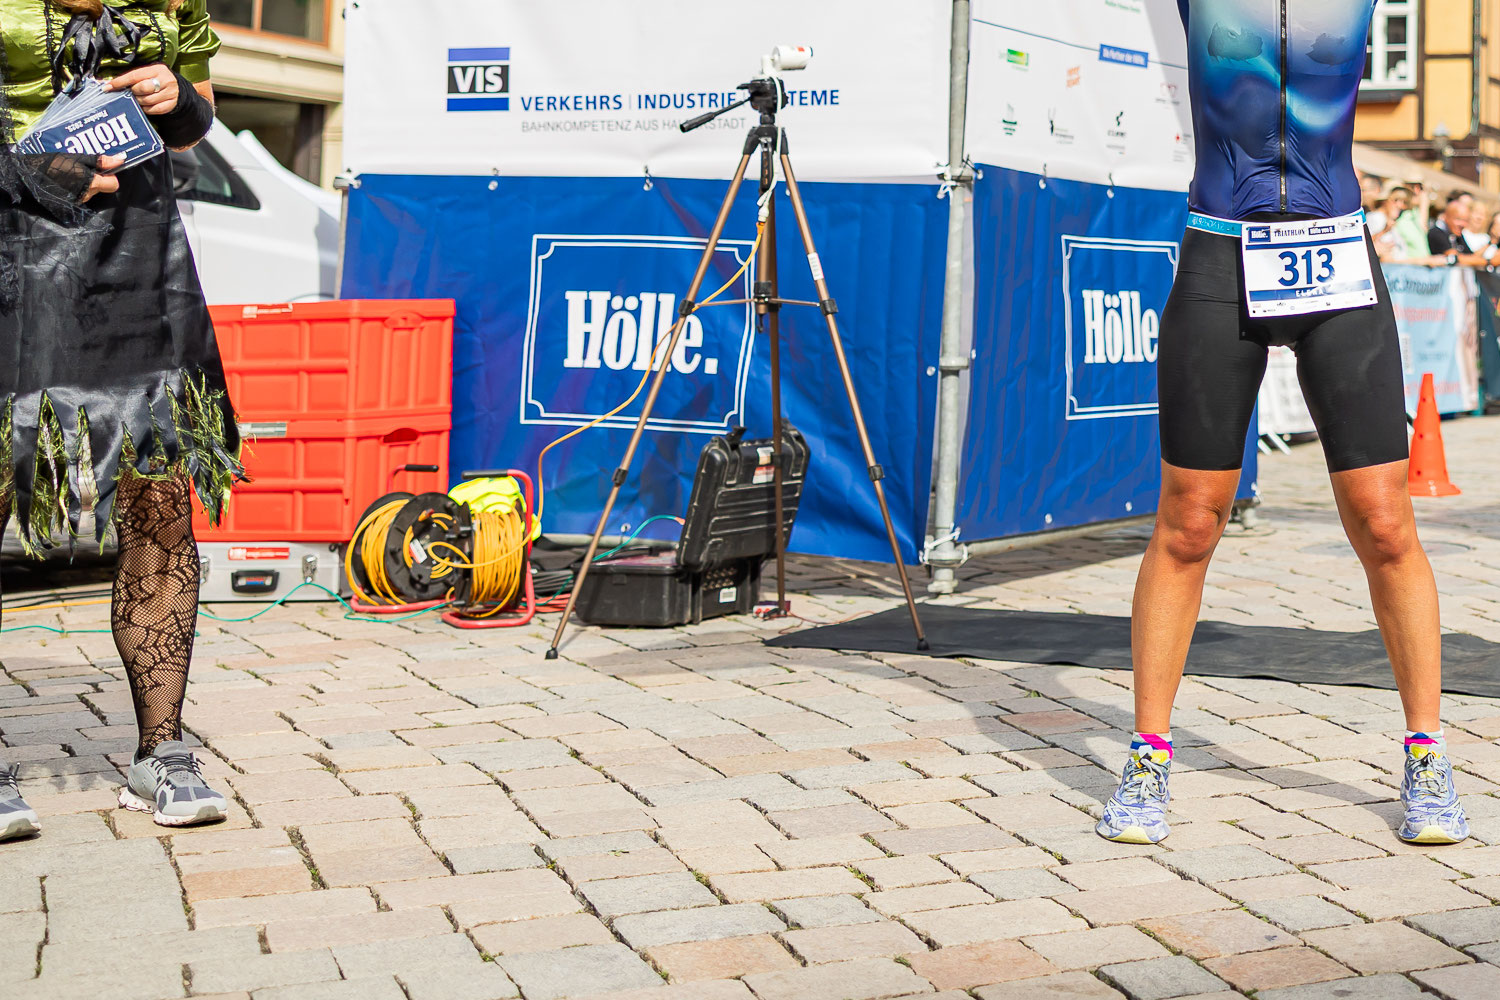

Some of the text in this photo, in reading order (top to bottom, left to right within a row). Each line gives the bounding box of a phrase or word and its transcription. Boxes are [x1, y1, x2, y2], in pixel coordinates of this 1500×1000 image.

[452, 66, 504, 93] VIS
[521, 89, 840, 112] VERKEHRS INDUSTRIE TEME
[54, 112, 139, 155] Hölle.
[521, 119, 632, 133] BAHNKOMPETENZ
[634, 119, 659, 132] AUS
[1274, 228, 1305, 237] TRIATHLON
[1277, 247, 1335, 287] 313
[563, 290, 719, 375] Hölle.
[1081, 289, 1160, 364] Hölle
